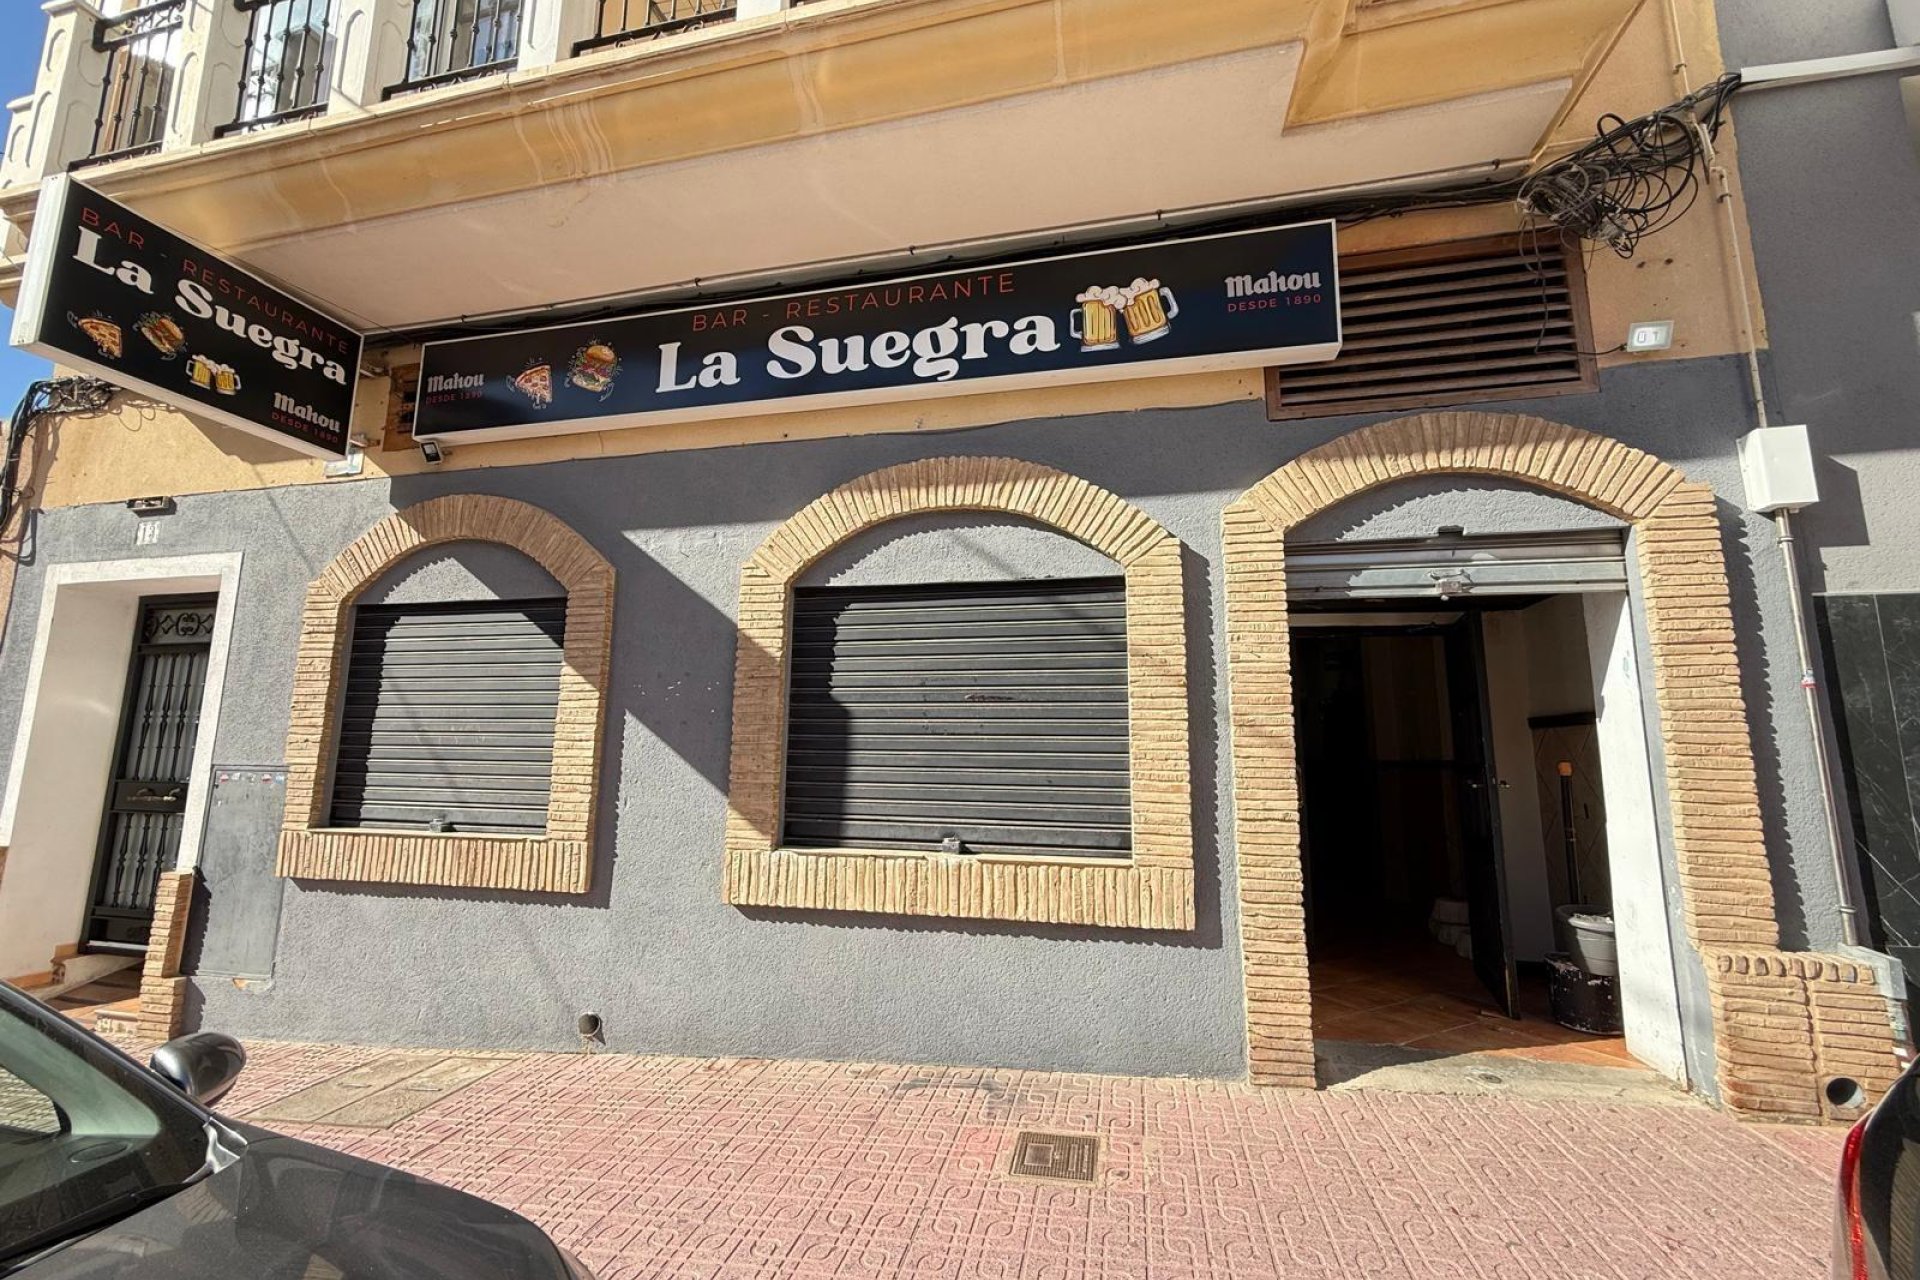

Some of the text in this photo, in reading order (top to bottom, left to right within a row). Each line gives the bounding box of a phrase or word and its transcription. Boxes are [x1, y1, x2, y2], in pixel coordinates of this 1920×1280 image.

[72, 225, 347, 386] La Suegra
[82, 207, 145, 250] BAR
[183, 258, 349, 355] RESTAURANTE
[692, 308, 748, 332] BAR
[786, 273, 1016, 320] RESTAURANTE
[1225, 270, 1322, 298] Mahou
[1227, 293, 1322, 313] DESDE 1890
[655, 314, 1061, 394] La Suegra
[427, 372, 485, 393] Mahou
[273, 392, 340, 433] Mahou
